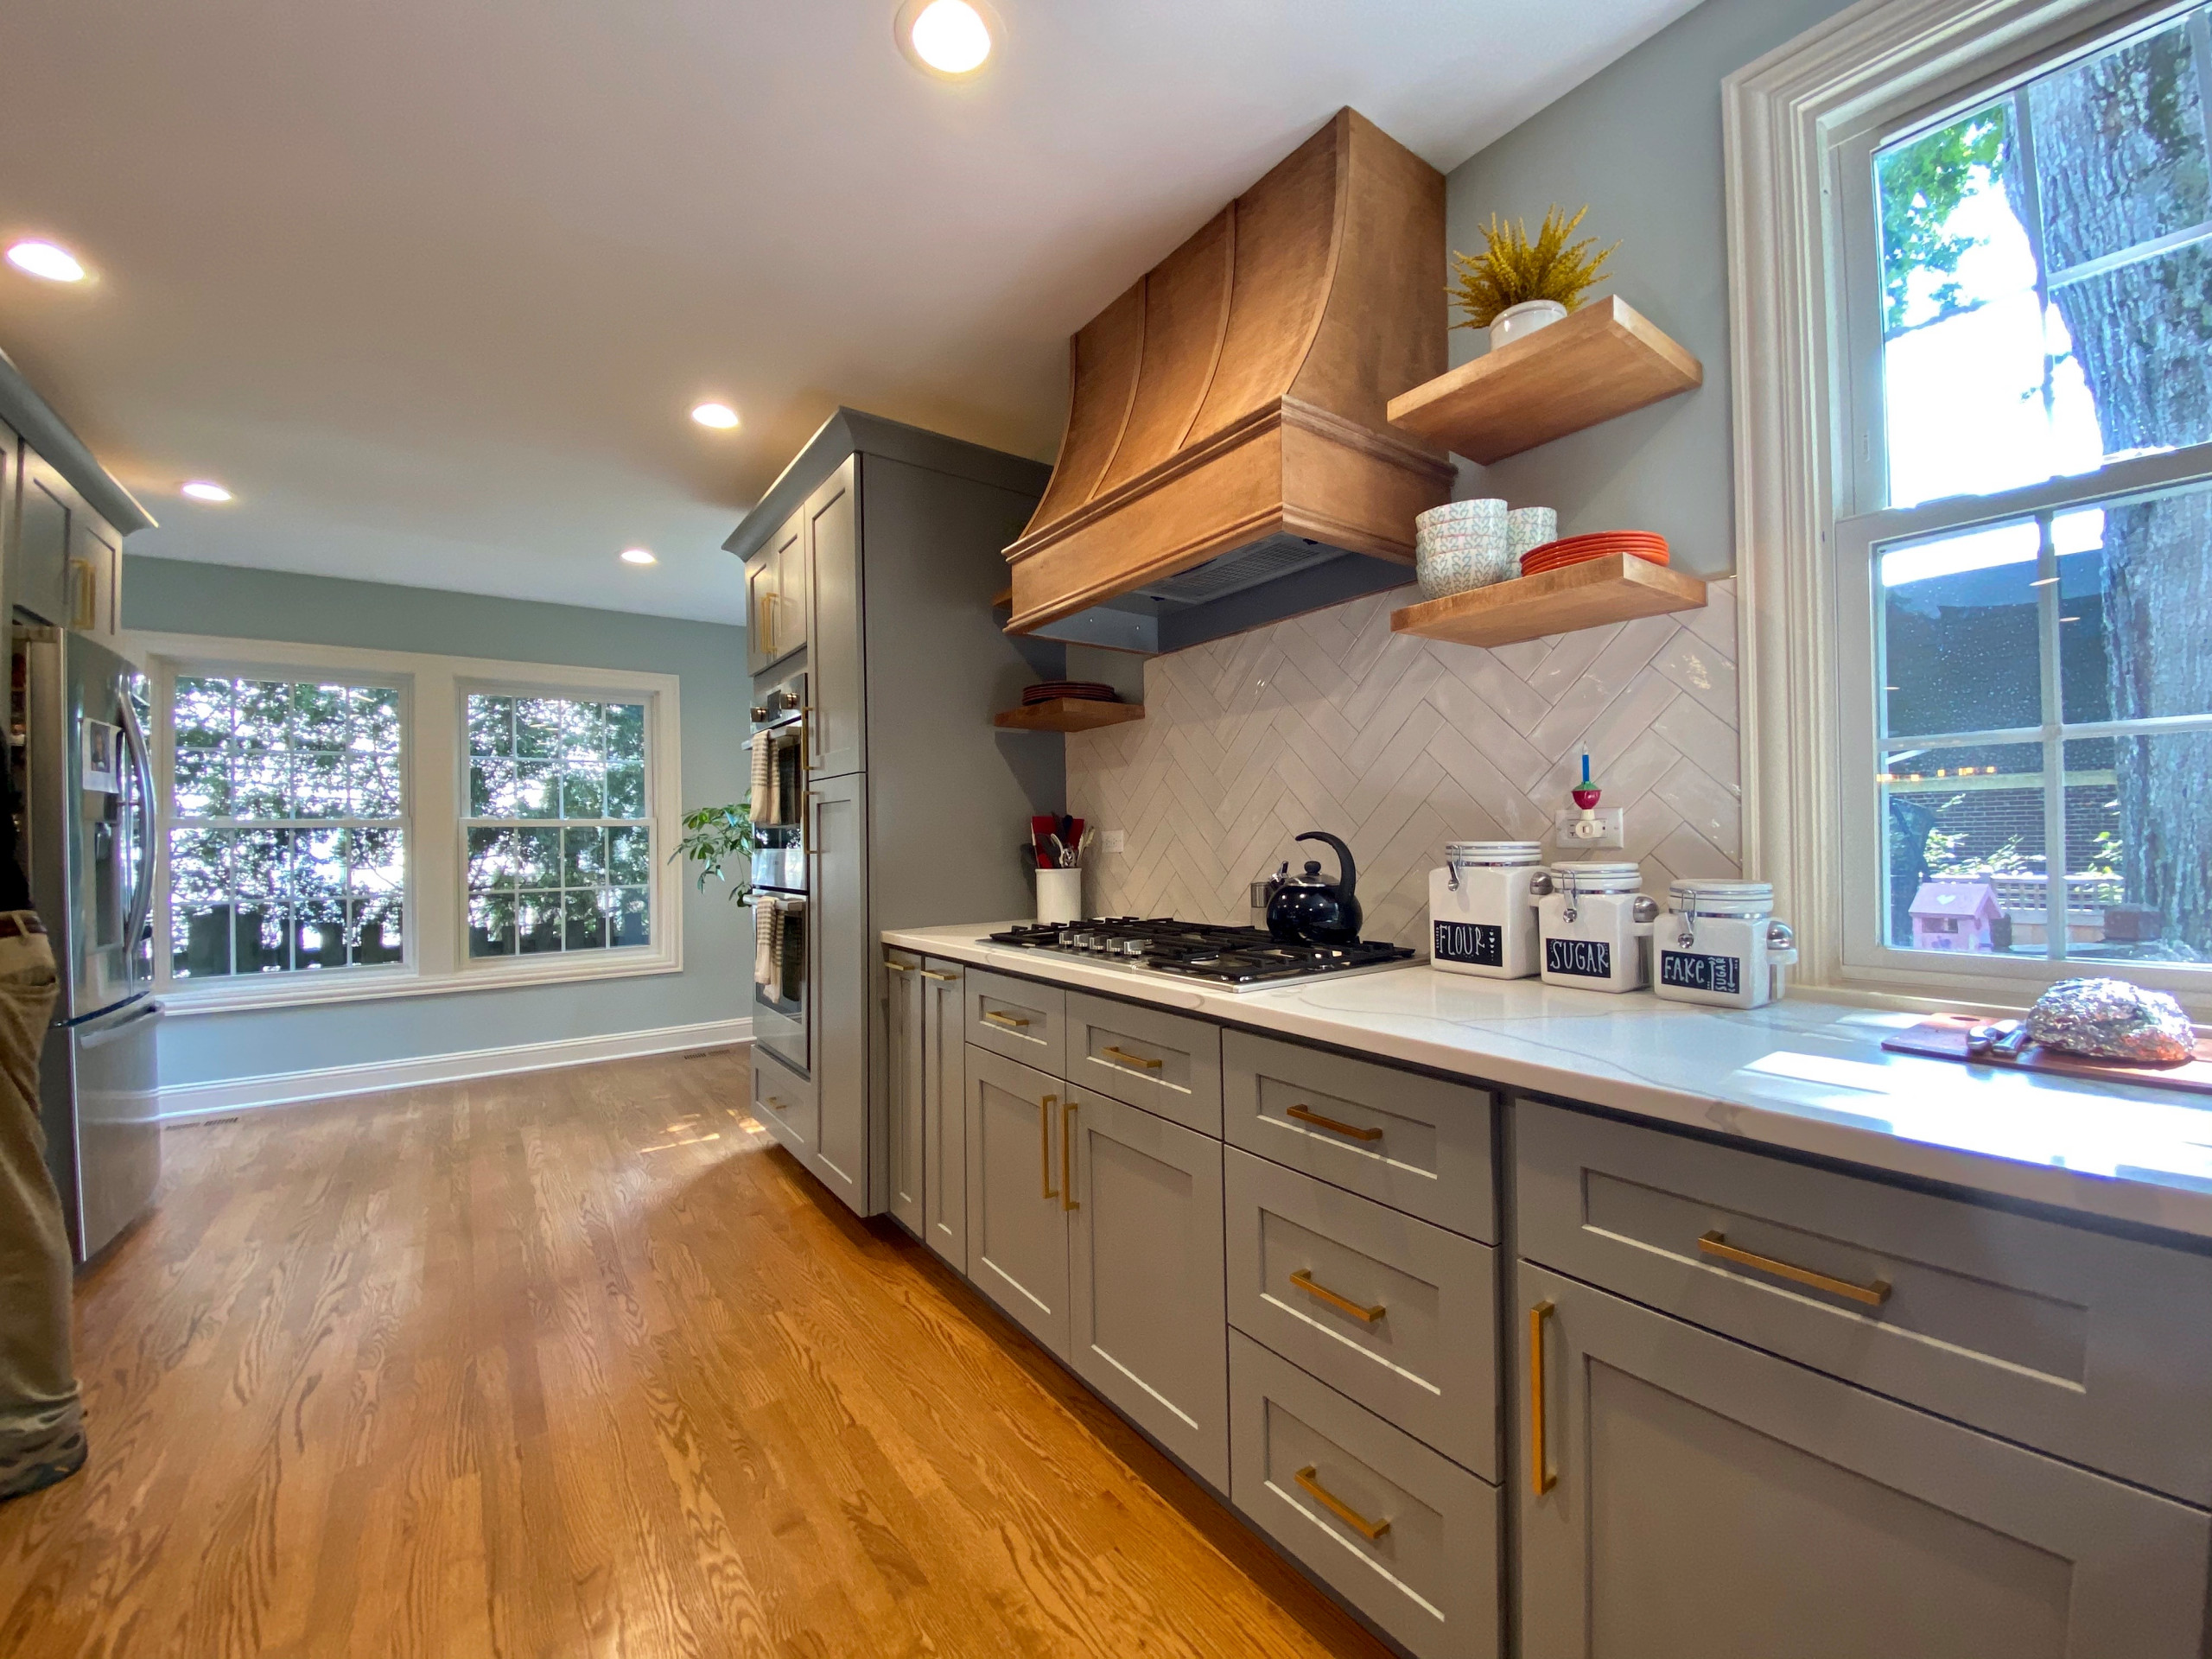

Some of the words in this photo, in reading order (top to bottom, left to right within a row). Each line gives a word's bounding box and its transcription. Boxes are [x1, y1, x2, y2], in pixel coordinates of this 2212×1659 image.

[1439, 924, 1485, 956] FLOUR
[1549, 940, 1609, 974] SUGAR
[1714, 957, 1727, 991] SUGAR
